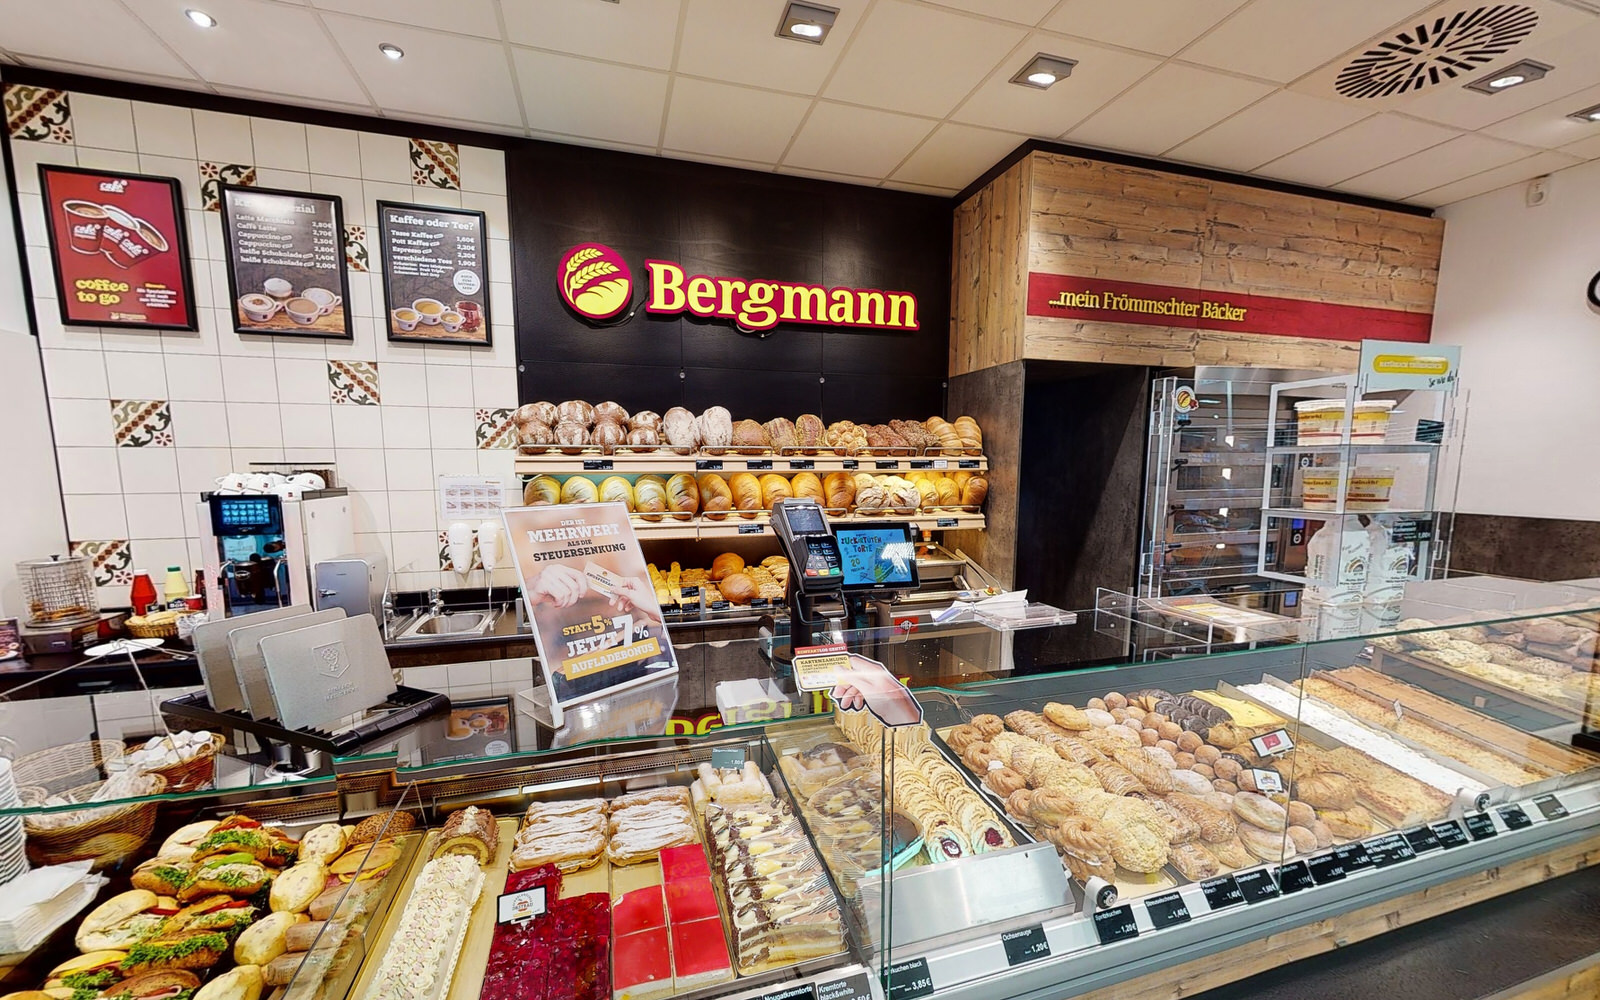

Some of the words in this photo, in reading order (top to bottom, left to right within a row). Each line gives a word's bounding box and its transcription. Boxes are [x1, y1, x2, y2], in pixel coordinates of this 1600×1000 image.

[389, 215, 424, 226] Kaffee
[426, 219, 450, 228] oder
[451, 221, 474, 231] Tee?
[76, 279, 129, 292] coffee
[77, 290, 97, 302] to
[99, 293, 120, 305] go
[647, 261, 919, 330] Bergmann
[1102, 291, 1200, 318] Frömmschter
[1201, 301, 1247, 321] Bäcker
[527, 523, 620, 544] MEHRWERT
[533, 543, 626, 562] STEUERSENKUNG
[562, 622, 592, 636] STATT
[566, 631, 618, 658] JETZT
[571, 643, 655, 674] AUFLADEBONUS
[1095, 908, 1122, 921] Spritzkuchen
[1002, 929, 1032, 941] Ochsenauge
[1121, 923, 1137, 933] 1,20€
[1031, 941, 1049, 953] 1,20€
[909, 960, 923, 969] black
[818, 981, 847, 993] Kremtorte
[911, 977, 932, 990] 3,85€
[764, 985, 813, 1000] Nougatkremtorte
[820, 988, 855, 1000] black&white
